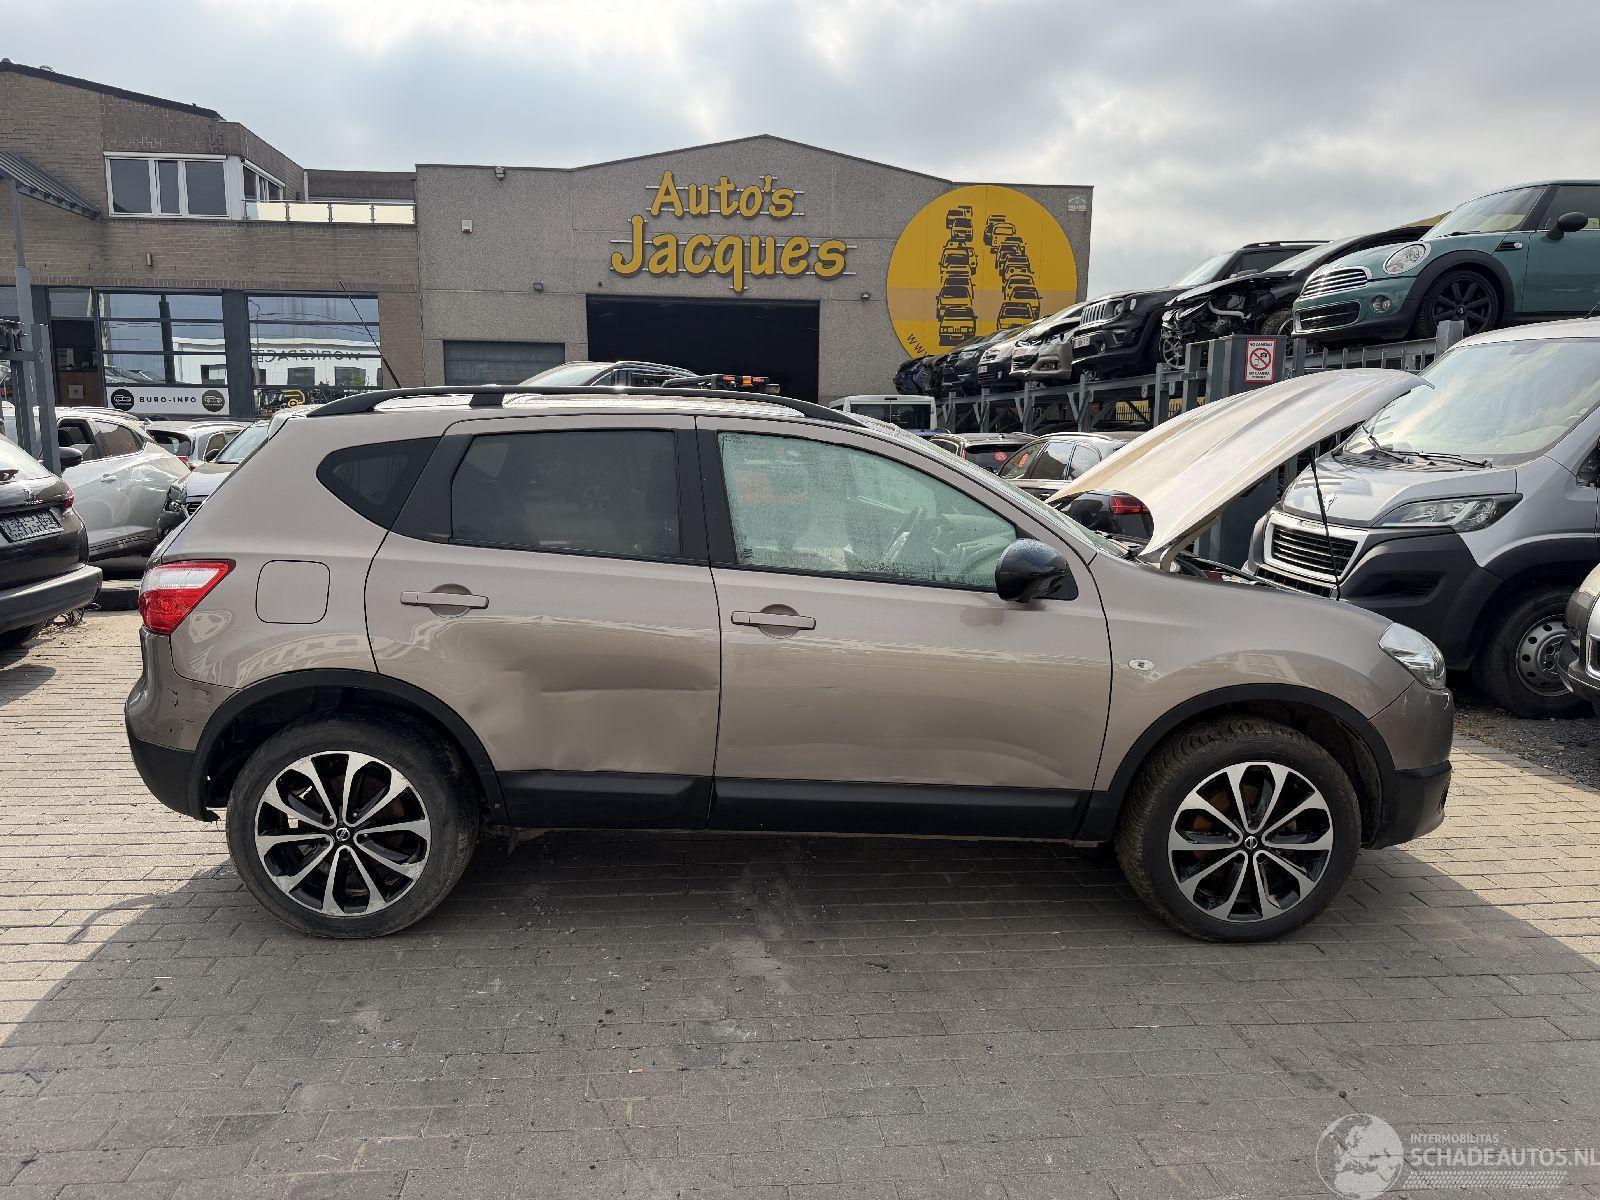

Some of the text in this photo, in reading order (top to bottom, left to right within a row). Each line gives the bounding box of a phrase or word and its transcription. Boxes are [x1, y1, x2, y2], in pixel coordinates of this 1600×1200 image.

[650, 170, 795, 219] Auto's
[611, 215, 847, 292] Jacques
[906, 333, 928, 356] ww
